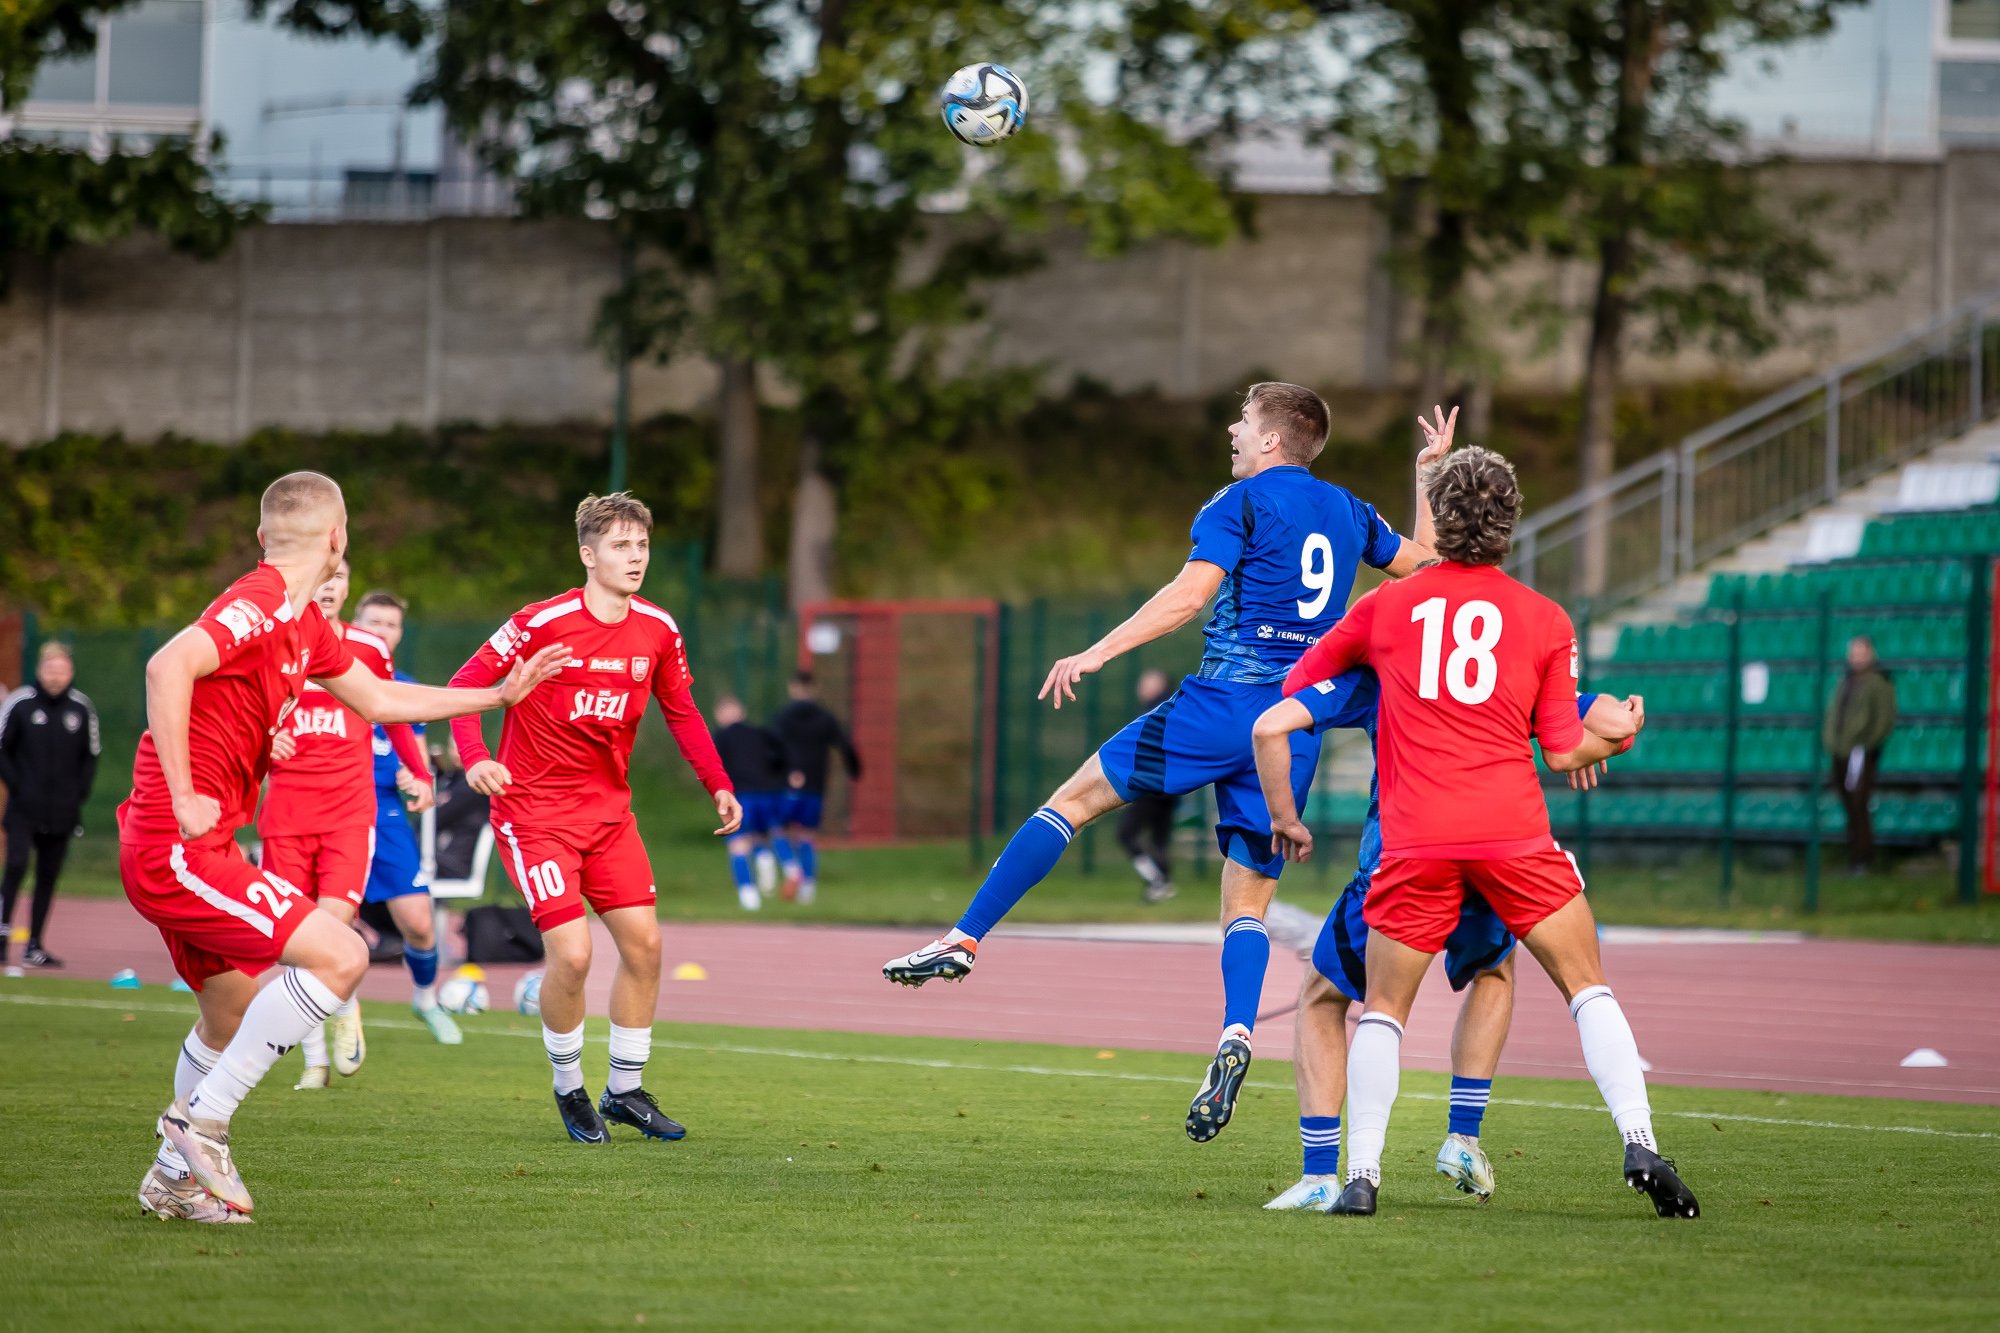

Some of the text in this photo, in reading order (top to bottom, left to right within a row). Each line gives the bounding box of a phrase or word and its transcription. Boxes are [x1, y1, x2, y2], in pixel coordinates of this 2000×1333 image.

[1297, 533, 1334, 620] 9
[1277, 631, 1305, 642] TERMY
[1411, 597, 1503, 705] 18
[246, 870, 304, 919] 24
[528, 860, 566, 902] 10
